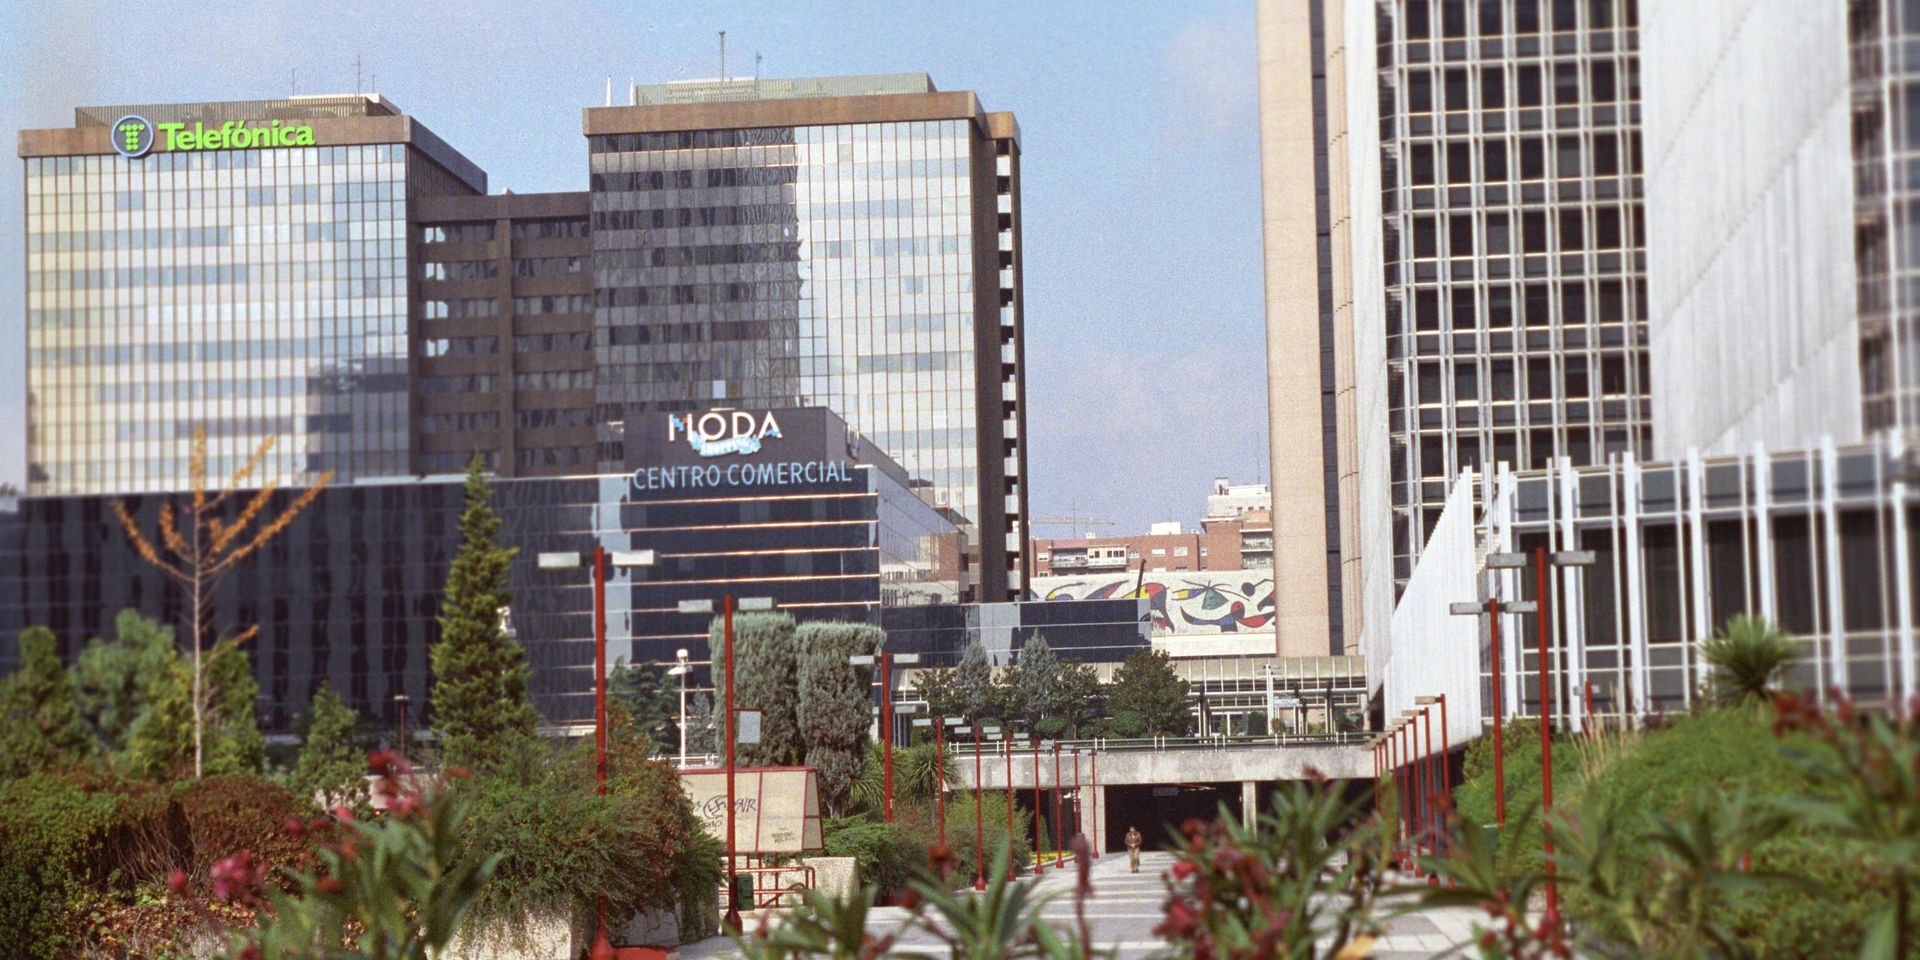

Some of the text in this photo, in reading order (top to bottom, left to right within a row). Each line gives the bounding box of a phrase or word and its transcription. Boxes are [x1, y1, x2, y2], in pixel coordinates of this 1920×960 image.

[158, 119, 316, 151] Telefónica
[669, 409, 783, 442] MODA
[633, 460, 852, 490] CENTRO COMERCIAL
